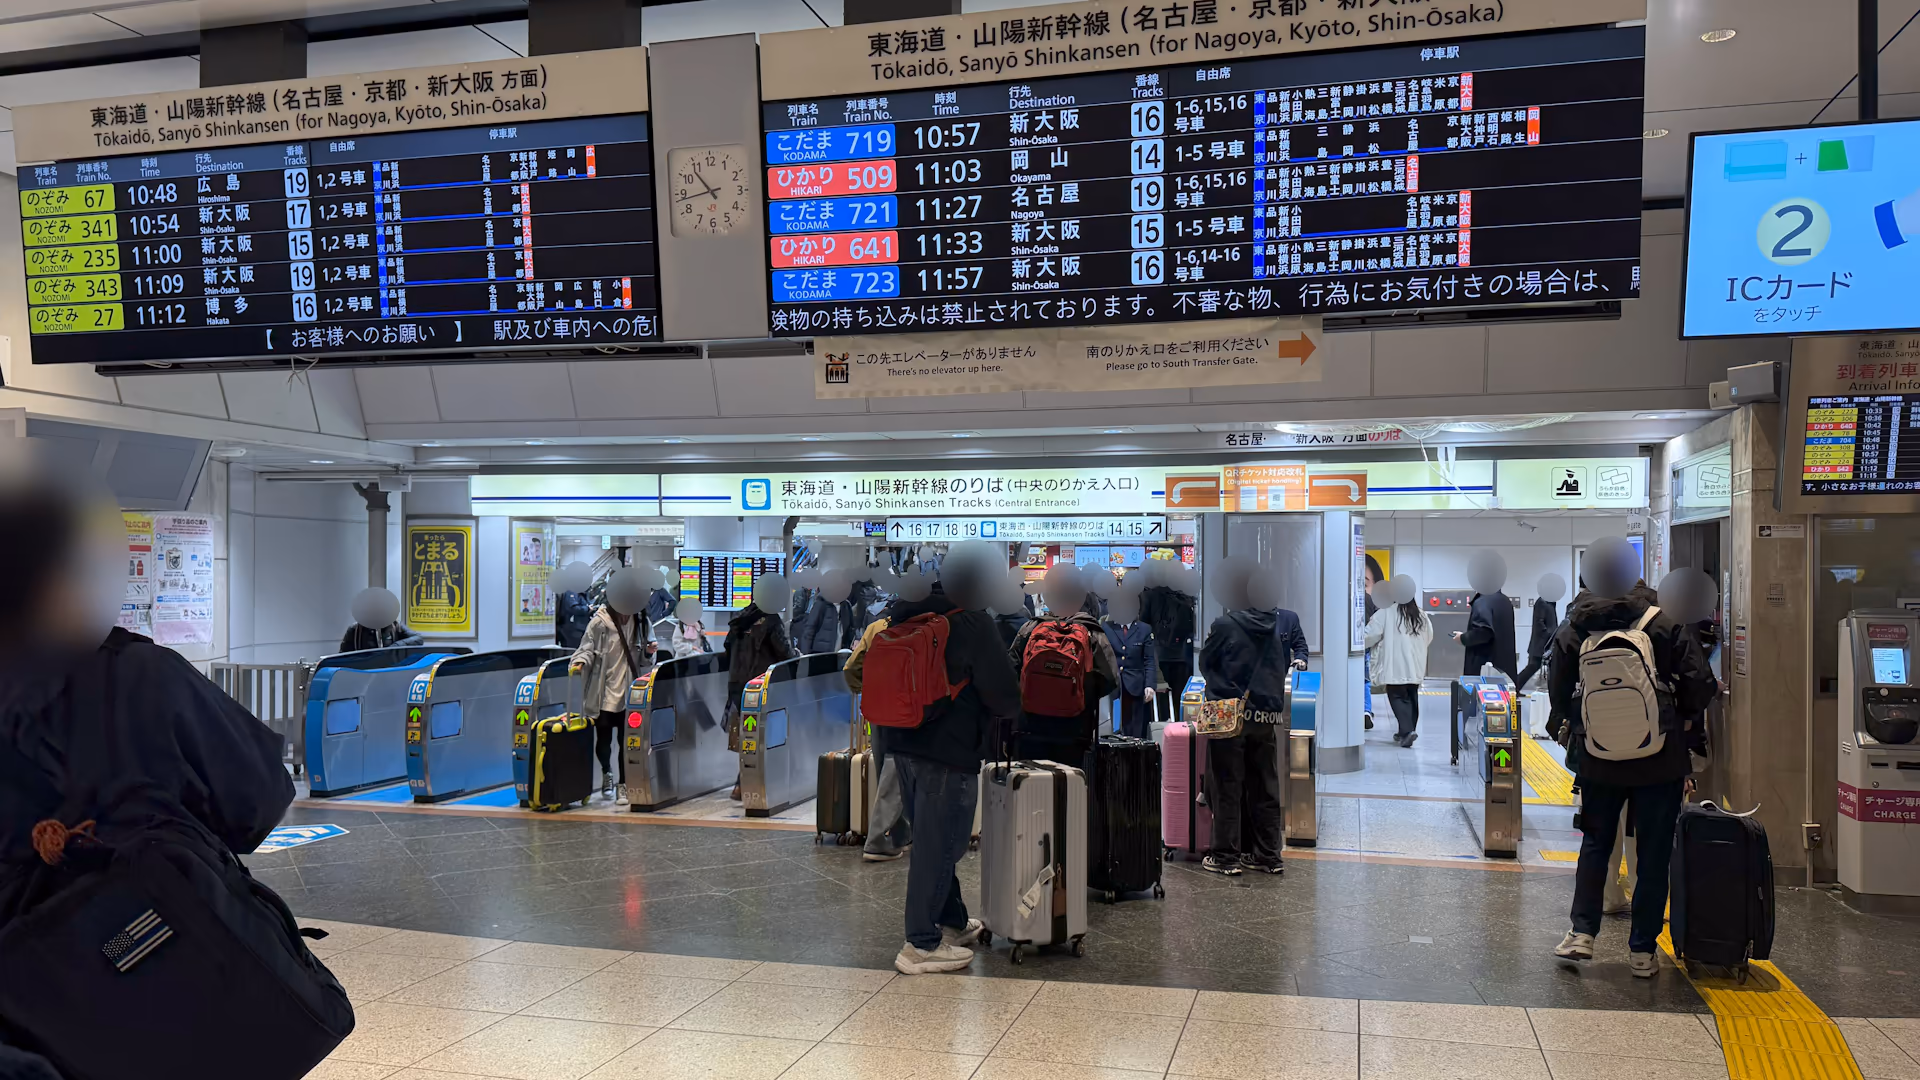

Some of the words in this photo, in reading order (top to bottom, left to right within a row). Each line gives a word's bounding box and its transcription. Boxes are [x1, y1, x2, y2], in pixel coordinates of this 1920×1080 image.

[871, 57, 953, 81] Tōkaidō,
[959, 51, 1018, 74] Sanyō
[1024, 40, 1140, 66] Shinkansen
[1149, 34, 1187, 56] (for
[1194, 28, 1282, 51] Nagoya,
[1289, 19, 1360, 42] Kyōto,
[1367, 3, 1504, 34] Shin-Ōsaka)
[787, 103, 819, 116] 列車名
[846, 98, 889, 112] 列車番号
[935, 91, 956, 104] 時刻
[1009, 85, 1032, 98] 行先
[1196, 66, 1232, 82] 自由席
[1420, 46, 1460, 61] 停車駅
[790, 115, 817, 126] Train
[844, 111, 869, 123] Train
[873, 110, 893, 121] No.
[933, 104, 960, 115] Time
[1009, 94, 1075, 110] Destination
[1131, 86, 1163, 98] Tracks
[94, 128, 155, 147] Tōkaidō,
[158, 121, 201, 143] Sanyō
[205, 117, 290, 138] Shinkansen
[294, 115, 323, 133] (for
[327, 111, 390, 130] Nagoya,
[395, 105, 447, 124] Kyōto,
[451, 92, 547, 117] Shin-Ōsaka)
[777, 130, 833, 151] こだま
[846, 129, 892, 153] 719
[914, 122, 981, 150] 10:57
[1009, 109, 1080, 134] 新大阪
[1133, 105, 1161, 132] 16
[1174, 95, 1248, 115] 1-6,15,16
[783, 150, 827, 161] KODAMA
[1009, 133, 1058, 147] Shin-Ōsaka
[691, 162, 702, 173] 11
[721, 160, 727, 171] 1
[704, 156, 716, 167] 12
[682, 174, 694, 184] 10
[732, 170, 739, 182] 2
[776, 166, 834, 187] ひかり
[847, 165, 893, 190] 509
[914, 158, 982, 186] 11:03
[790, 185, 822, 195] HIKARI
[1009, 172, 1052, 184] Okayama
[26, 189, 70, 207] のぞみ
[84, 189, 105, 208] 67
[127, 183, 178, 206] 10:48
[286, 171, 307, 195] 19
[736, 185, 744, 196] 3
[35, 205, 64, 214] NOZOMI
[198, 194, 231, 204] Hiroshima
[685, 203, 693, 214] 8
[731, 200, 740, 211] 4
[849, 200, 893, 225] 721
[915, 195, 983, 221] 11:27
[1010, 183, 1080, 208] 名古屋
[29, 219, 72, 237] のぞみ
[80, 219, 112, 239] 341
[129, 212, 180, 235] 10:54
[199, 203, 251, 224] 新大阪
[696, 213, 704, 224] 7
[723, 212, 731, 223] 5
[709, 217, 717, 228] 6
[1010, 208, 1044, 220] Nagoya
[199, 223, 236, 235] Shin-Ōsaka
[1771, 204, 1814, 258] 2
[848, 235, 892, 260] 641
[916, 230, 984, 256] 11:33
[83, 247, 116, 268] 235
[131, 243, 182, 265] 11:00
[85, 278, 119, 298] 343
[133, 273, 184, 296] 11:09
[850, 270, 895, 294] 723
[917, 266, 984, 291] 11:57
[1725, 271, 1853, 302] ICカード
[93, 307, 114, 327] 27
[136, 303, 187, 326] 11:12
[206, 316, 230, 326] Hakata
[1753, 305, 1822, 323] をタッチ
[856, 346, 1036, 365] この先エレベーターがありません
[1086, 337, 1269, 359] 南のりかえ口をご利用ください
[931, 366, 967, 375] elevator
[968, 366, 979, 374] up
[981, 364, 1003, 372] here.
[1106, 362, 1135, 371] Please
[1137, 363, 1149, 371] go
[1151, 361, 1161, 369] to
[1163, 359, 1190, 368] South
[1193, 357, 1231, 367] Transfer
[1232, 356, 1258, 365] Gate.
[1837, 361, 1920, 380] 到着列車
[1849, 380, 1891, 392] Arrival
[1225, 468, 1305, 478] QRチケット対応改札
[782, 498, 832, 511] Tōkaidō,
[835, 498, 872, 511] Sanyō
[875, 497, 945, 509] Shinkansen
[949, 497, 992, 508] Tracks
[994, 498, 1032, 508] (Central
[1034, 497, 1081, 508] Entrance)
[908, 523, 922, 537] 16
[926, 523, 941, 536] 17
[944, 522, 959, 536] 18
[963, 522, 977, 536] 19
[1108, 522, 1122, 535] 14
[1128, 522, 1143, 535] 15
[999, 521, 1105, 532] 東海道・山陽新幹線のりば
[414, 541, 459, 560] とまる
[411, 682, 425, 694] IC
[518, 684, 532, 696] IC
[1873, 811, 1917, 820] CHARGE
